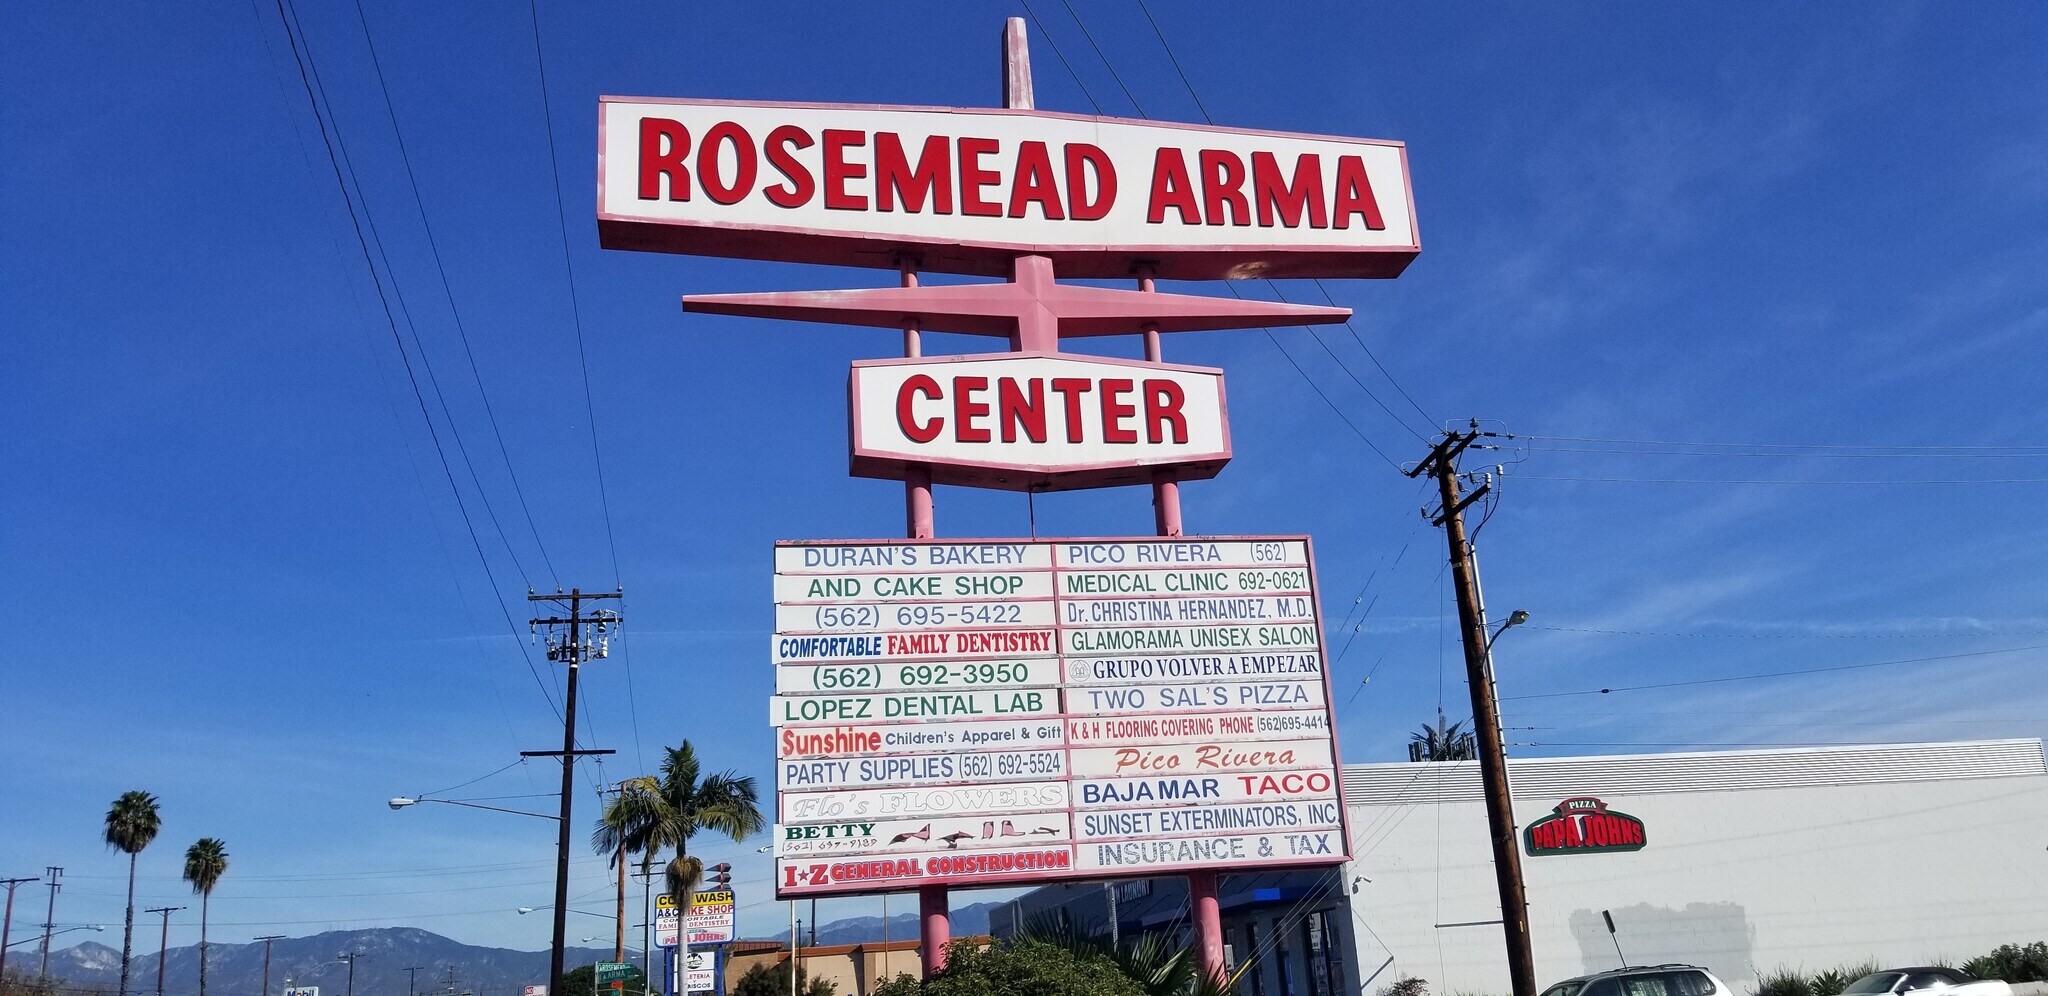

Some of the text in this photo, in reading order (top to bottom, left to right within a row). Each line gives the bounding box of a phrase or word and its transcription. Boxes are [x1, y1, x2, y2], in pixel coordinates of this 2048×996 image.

[637, 116, 1387, 232] ROSEMEAD ARMA
[895, 373, 1189, 445] CENTER
[804, 546, 1027, 567] DURAN'S BAKERY
[1069, 542, 1287, 563] PICO RIVERA (562)
[807, 575, 1024, 598] AND CAKE SHOP
[1067, 570, 1306, 592] MEDICAL CLINIC 692-0621
[815, 604, 1022, 629] (562) 695-5422
[1067, 602, 1089, 623] Dr.
[1091, 600, 1174, 623] CHRISTINA
[1276, 597, 1312, 618] M.D.
[779, 631, 1052, 659] COMFORTABLE FAMILY DENTISTRY
[1071, 626, 1315, 652] GLAMORAMA UNISEX SALON
[813, 662, 1029, 689] (562) 692-3950
[1093, 655, 1318, 679] GRUPO VOLVER A EMPEZAR
[785, 692, 1043, 721] LOPEZ DENTAL LAB
[1087, 684, 1309, 710] TWO SAL'S PIZZA
[782, 726, 1061, 756] Sunshine Children's Apparel & Gift
[1071, 722, 1078, 739] K
[1081, 721, 1090, 740] &
[1092, 721, 1099, 738] H
[1105, 719, 1159, 739] FLOORING
[1161, 717, 1214, 737] COVERING
[1219, 716, 1255, 735] PHONE
[786, 752, 1061, 786] PARTY SUPPLIES (562) 692-5524
[1114, 744, 1297, 774] Pico Rivera
[1236, 772, 1331, 796] TACO
[793, 786, 1063, 818] Flo's FLOWERS
[1569, 801, 1597, 809] PIZZA
[785, 824, 876, 840] BETTY
[1084, 812, 1153, 837] SUNSET
[1159, 804, 1302, 832] EXTERMINATORS,
[1532, 815, 1643, 849] PAPA JOHNS
[1098, 834, 1331, 866] INSURANCE & TAX
[830, 858, 923, 882] GENERAL
[926, 850, 1070, 874] CONSTRUCTION
[696, 892, 733, 902] WASH
[708, 904, 733, 914] SHOP
[689, 919, 729, 927] DENTISTRY
